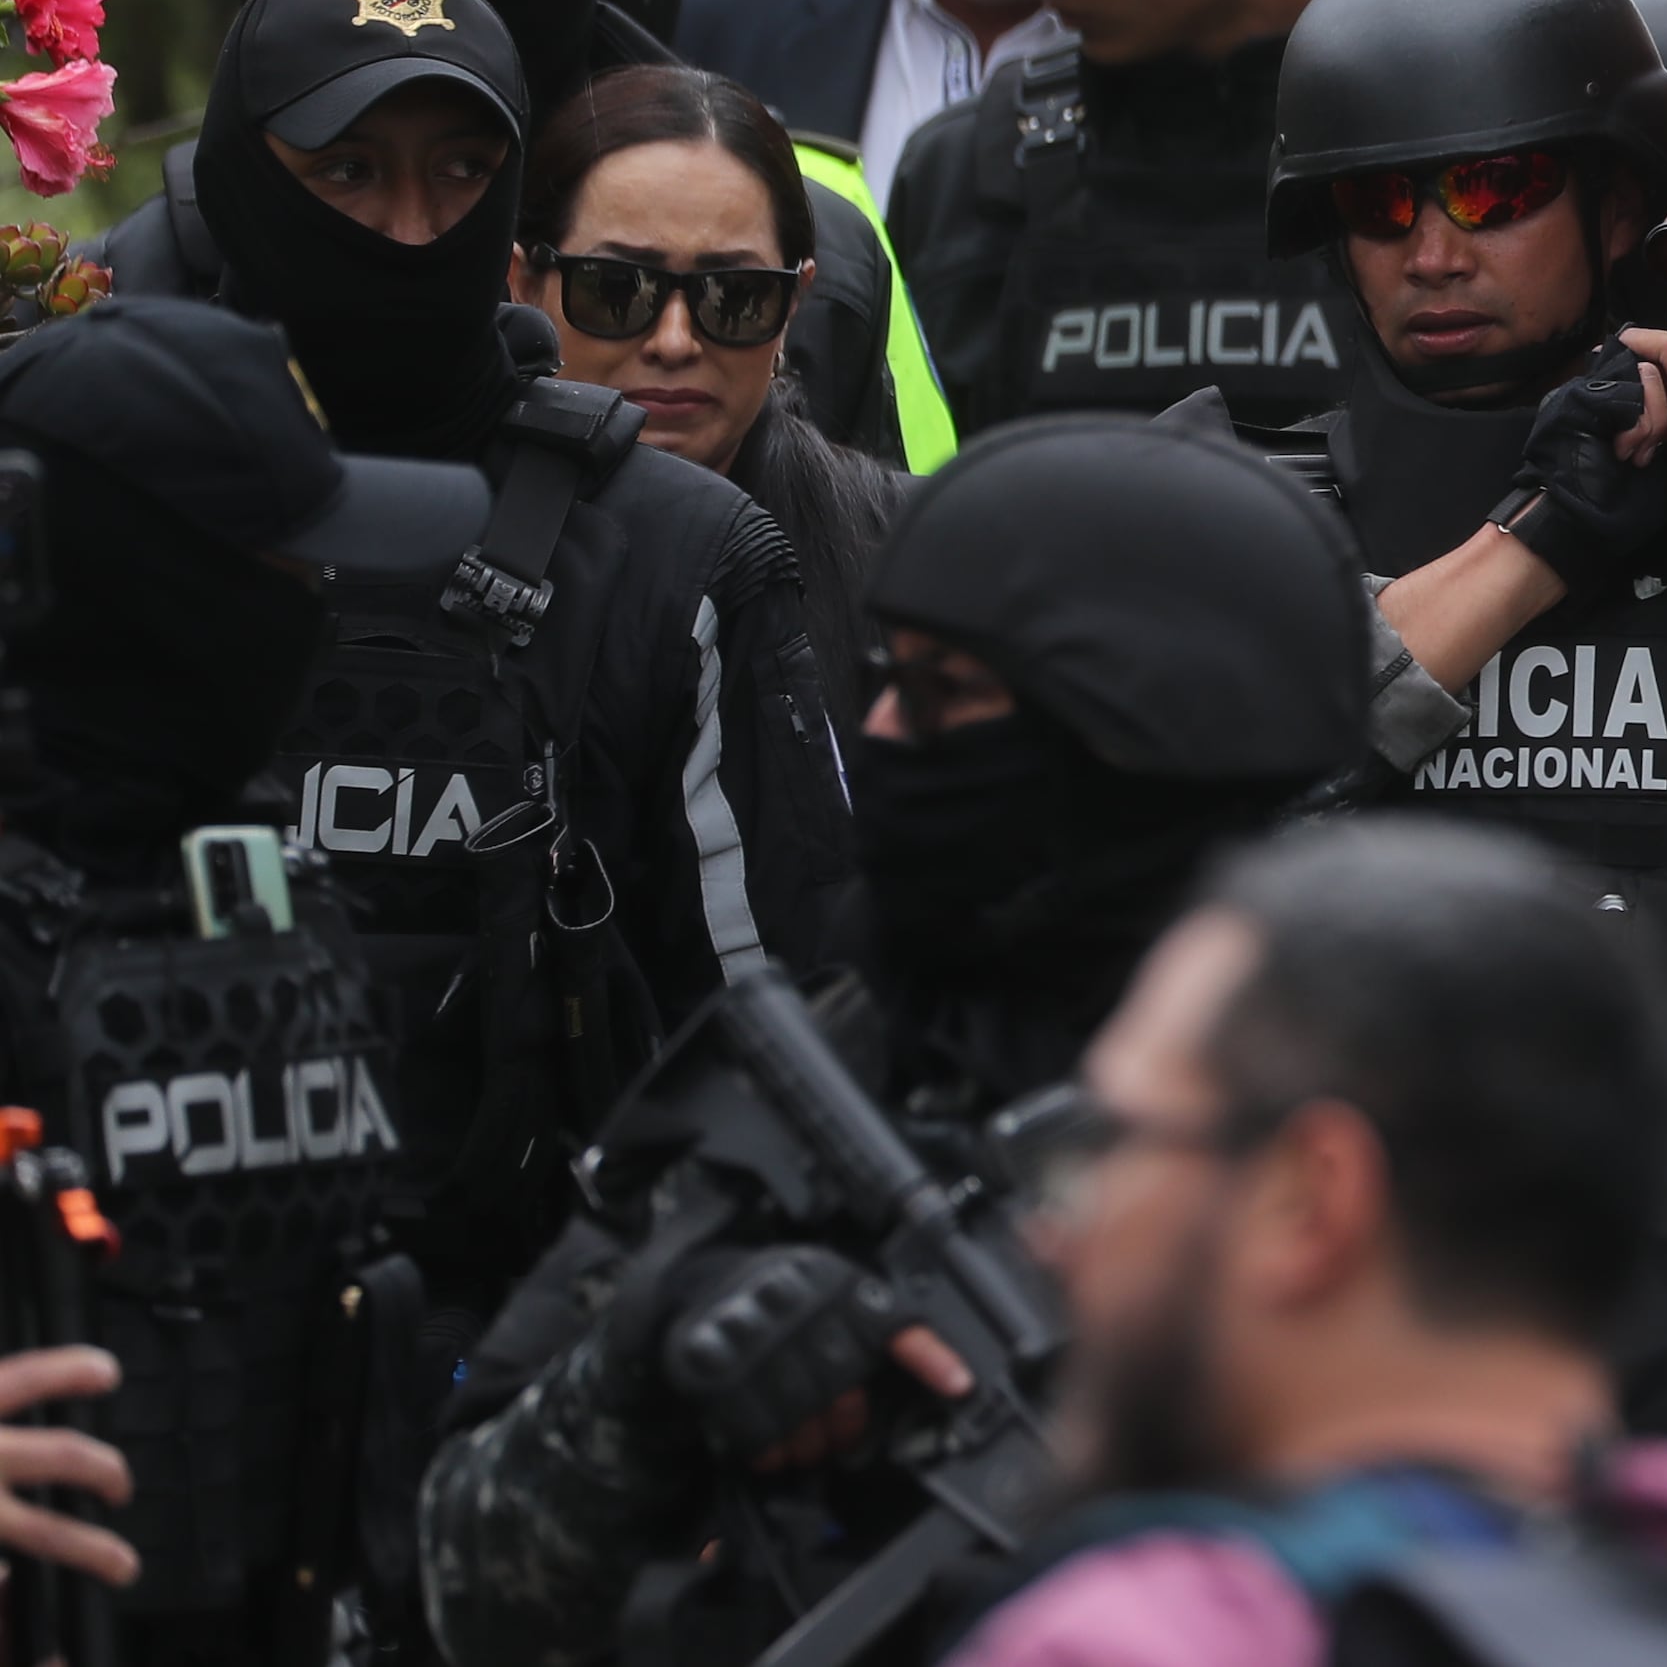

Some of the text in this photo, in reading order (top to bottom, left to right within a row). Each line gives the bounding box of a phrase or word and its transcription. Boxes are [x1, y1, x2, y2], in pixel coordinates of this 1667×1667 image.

[1042, 300, 1340, 373] POLICIA
[284, 761, 483, 857] ICIA
[1414, 747, 1667, 791] NACIONAL
[102, 1055, 400, 1186] POLICIA
